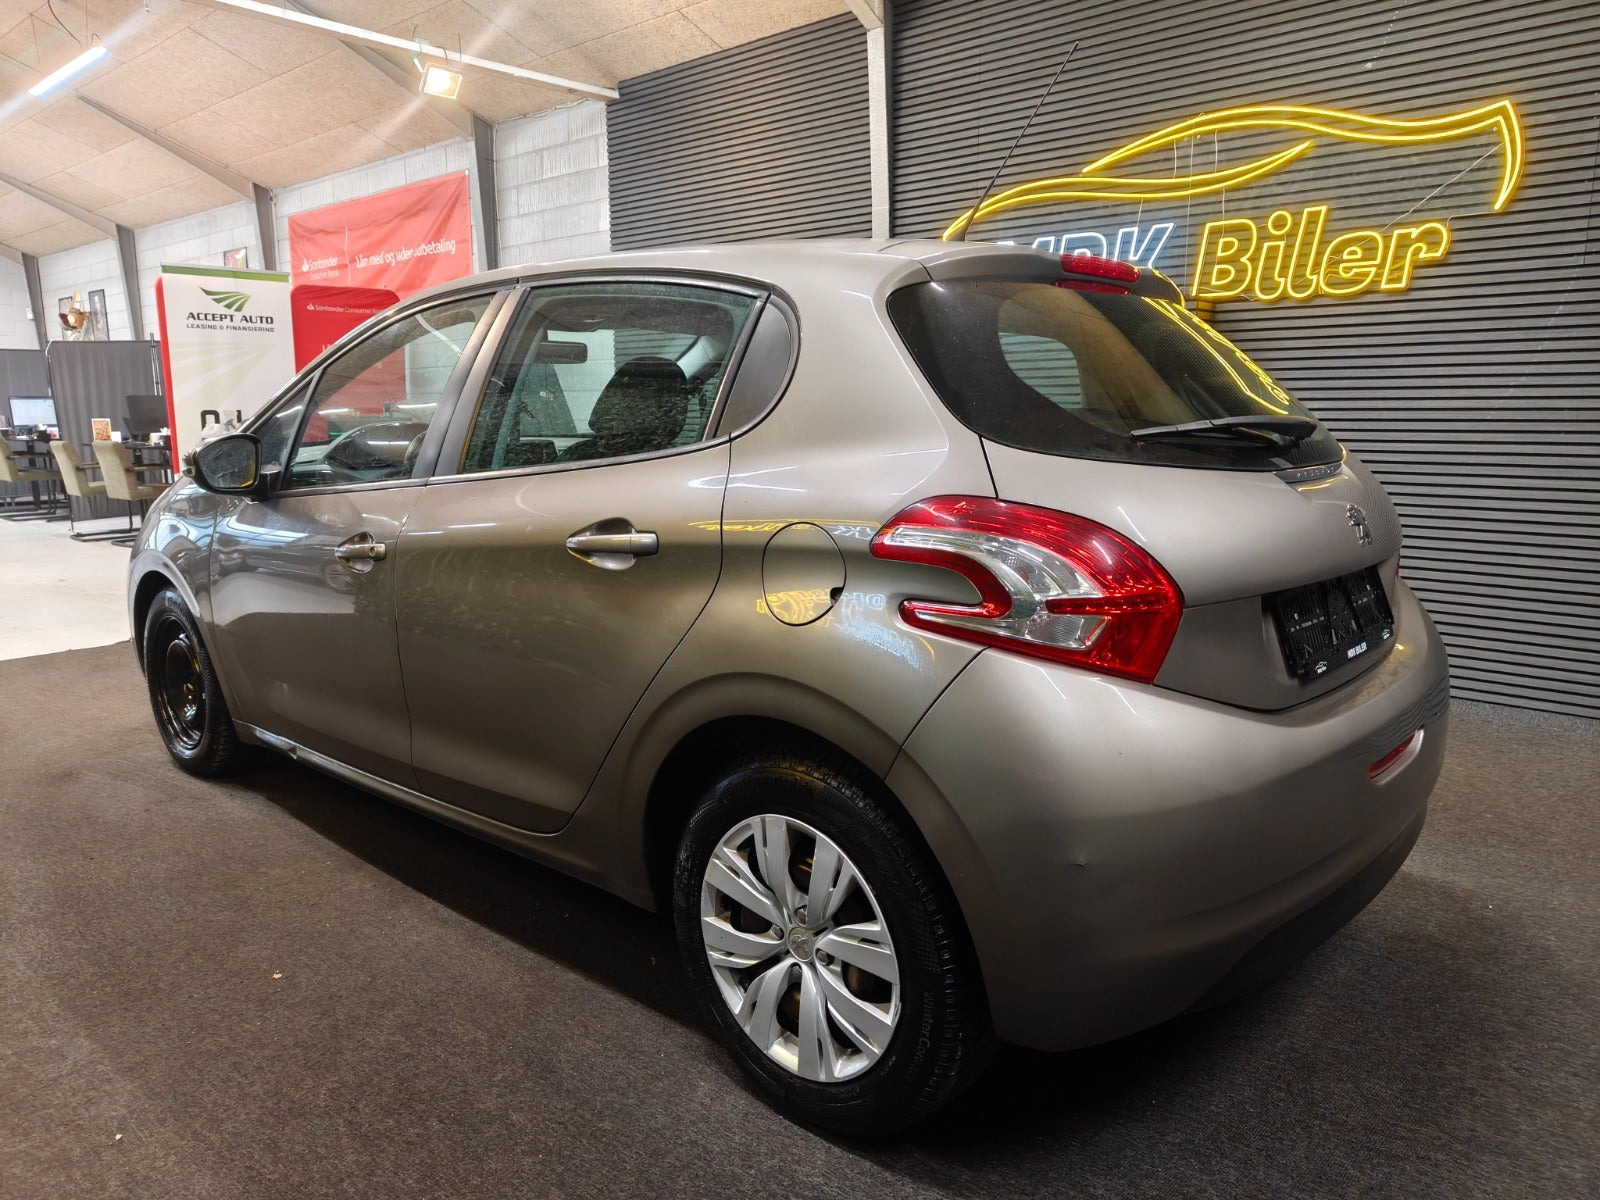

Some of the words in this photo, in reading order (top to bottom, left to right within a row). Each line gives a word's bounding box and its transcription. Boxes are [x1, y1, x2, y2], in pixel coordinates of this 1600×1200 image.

[385, 252, 396, 267] og
[1192, 205, 1451, 300] Biler
[309, 257, 339, 271] Santander
[314, 304, 344, 313] Santander
[187, 312, 235, 322] ACCEPT
[240, 315, 274, 325] AUTO
